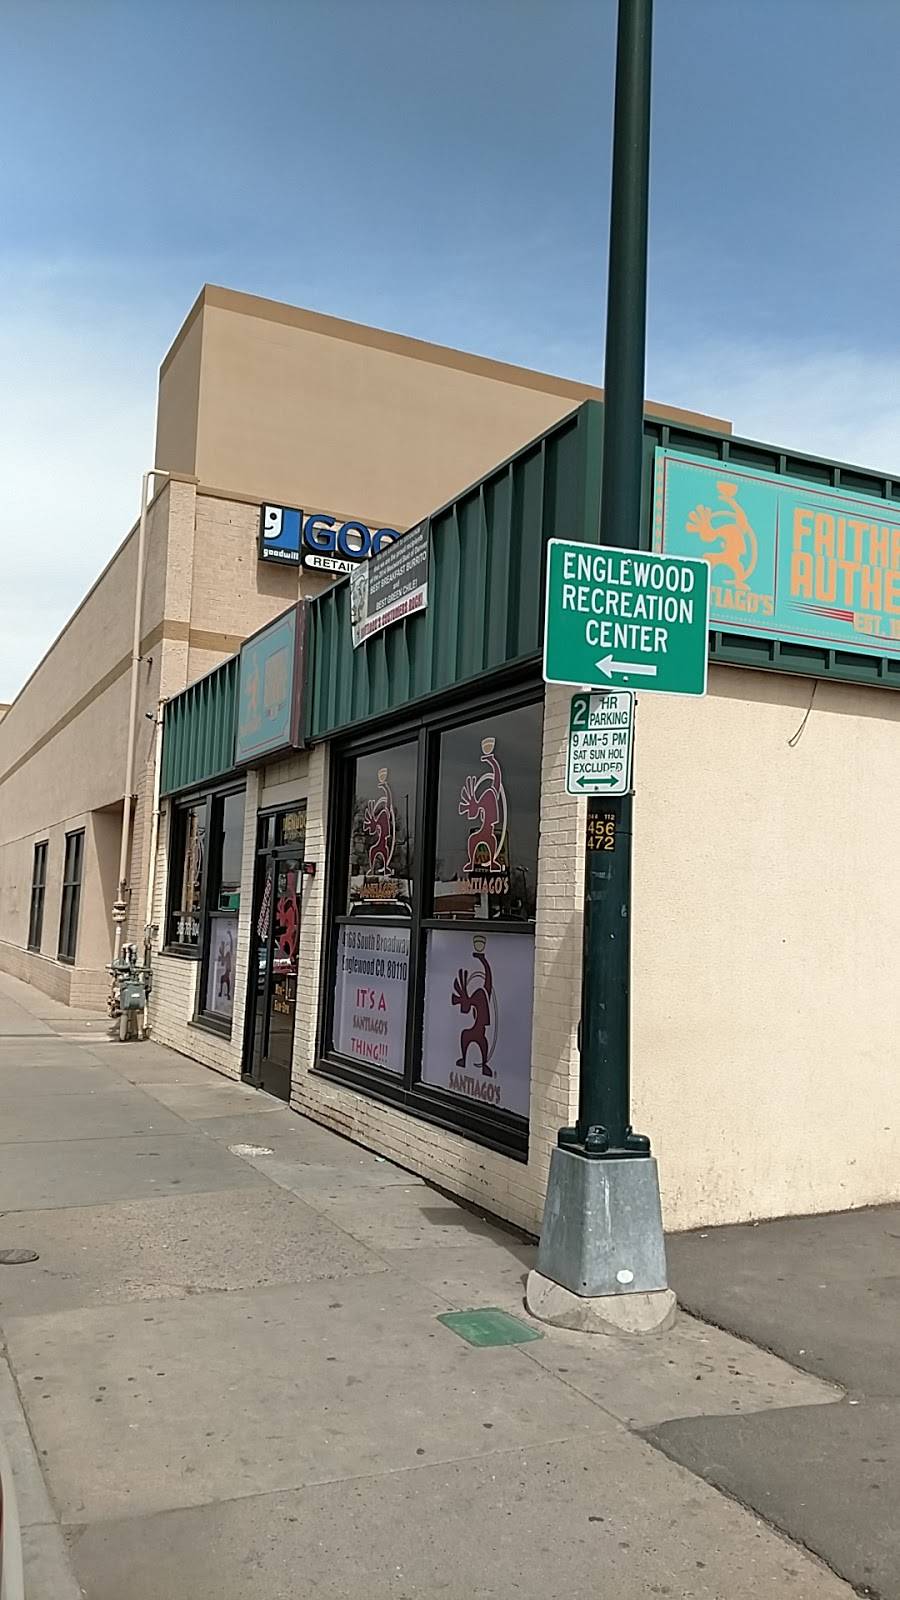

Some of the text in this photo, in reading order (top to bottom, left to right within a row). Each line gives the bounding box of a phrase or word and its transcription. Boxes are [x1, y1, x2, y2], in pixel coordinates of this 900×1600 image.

[263, 548, 299, 560] goodwill
[380, 564, 406, 588] BREAKFAST
[406, 551, 427, 572] BURRITO
[563, 551, 695, 593] ENGLEWOOD
[387, 588, 402, 604] GREEN
[562, 583, 694, 625] RECREATION
[585, 619, 668, 654] CENTER
[572, 696, 618, 725] 2 HR
[589, 711, 628, 726] PARKING
[572, 732, 627, 747] 9 AM-5 PM
[573, 748, 624, 761] SAT SUN HOL
[573, 762, 623, 774] EXCLUDED
[588, 820, 616, 836] 456
[587, 834, 615, 850] 472
[357, 931, 375, 950] South
[376, 933, 409, 957] Broadway
[387, 959, 408, 981] 80110
[356, 987, 386, 1012] IT'S A
[351, 1037, 388, 1063] THING!!!
[448, 1071, 501, 1105] SANTIAGO'S
